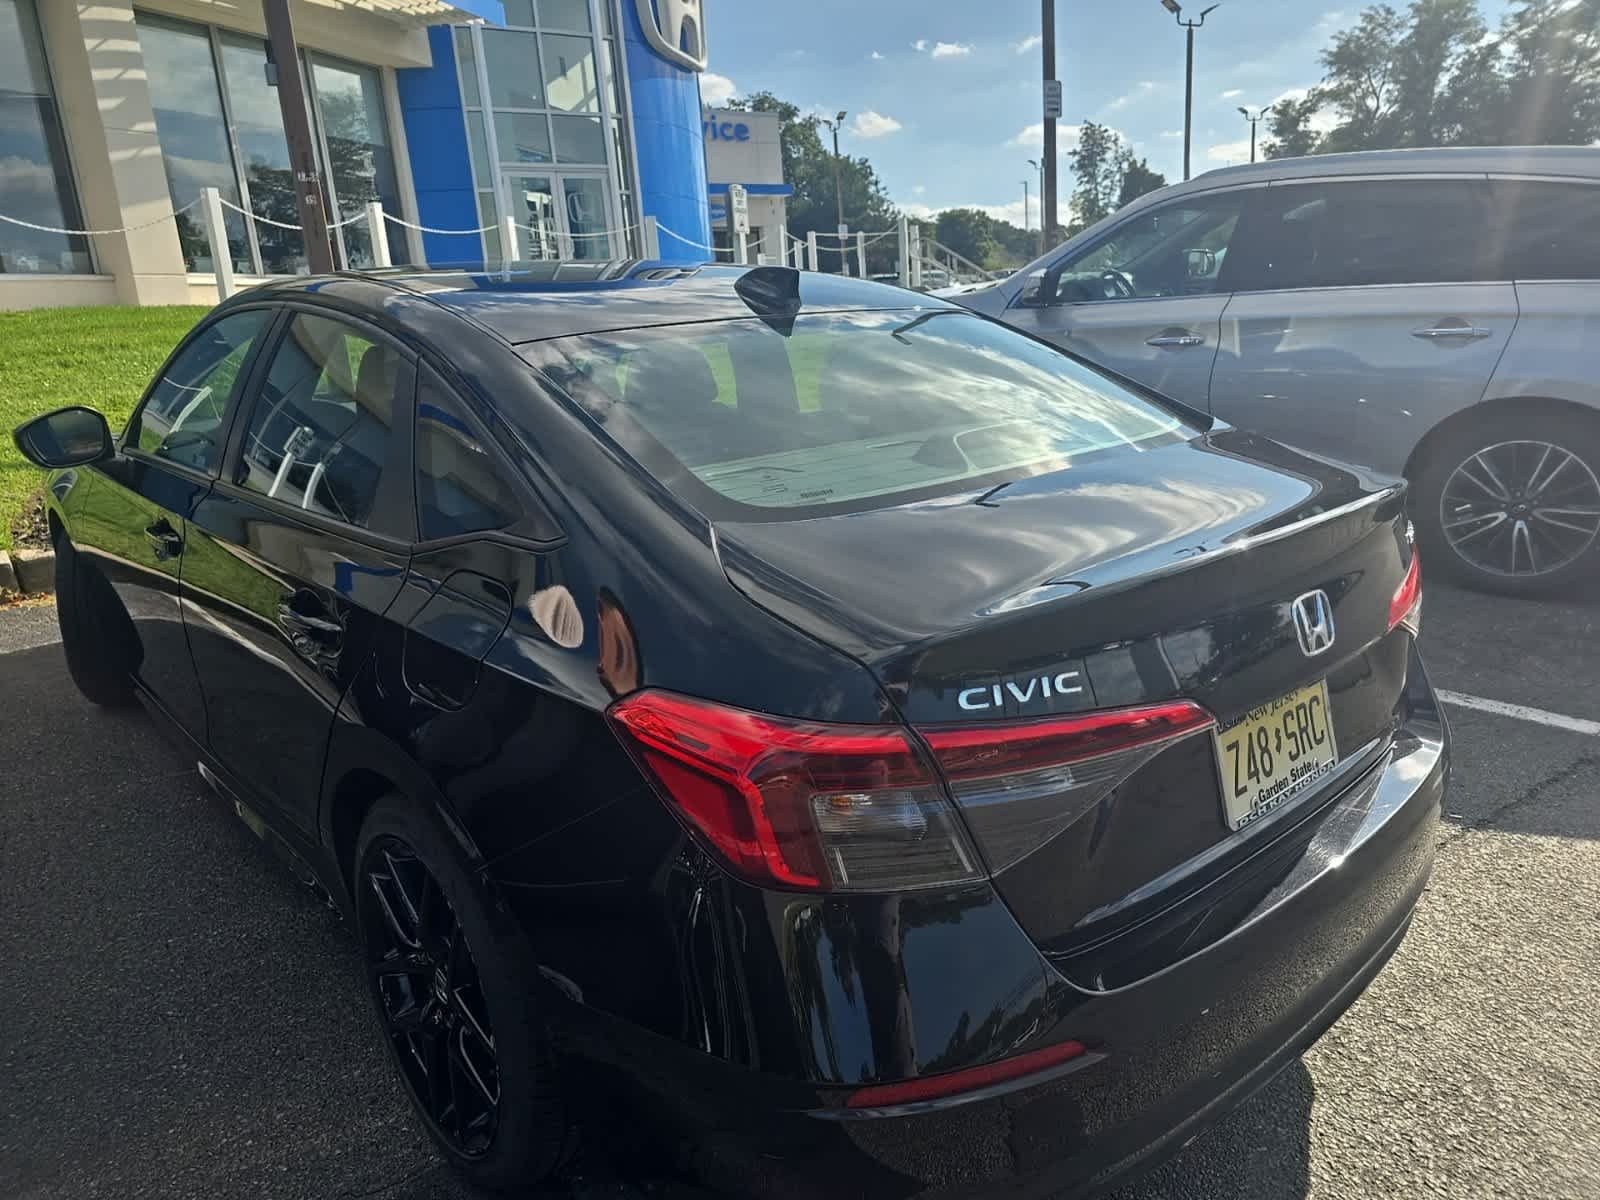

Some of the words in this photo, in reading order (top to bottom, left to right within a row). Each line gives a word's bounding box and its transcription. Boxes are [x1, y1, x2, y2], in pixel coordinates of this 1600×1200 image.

[958, 671, 1083, 710] CIVIC
[1258, 776, 1289, 803] Garden
[1290, 761, 1312, 782] State
[1295, 760, 1336, 792] HONDA
